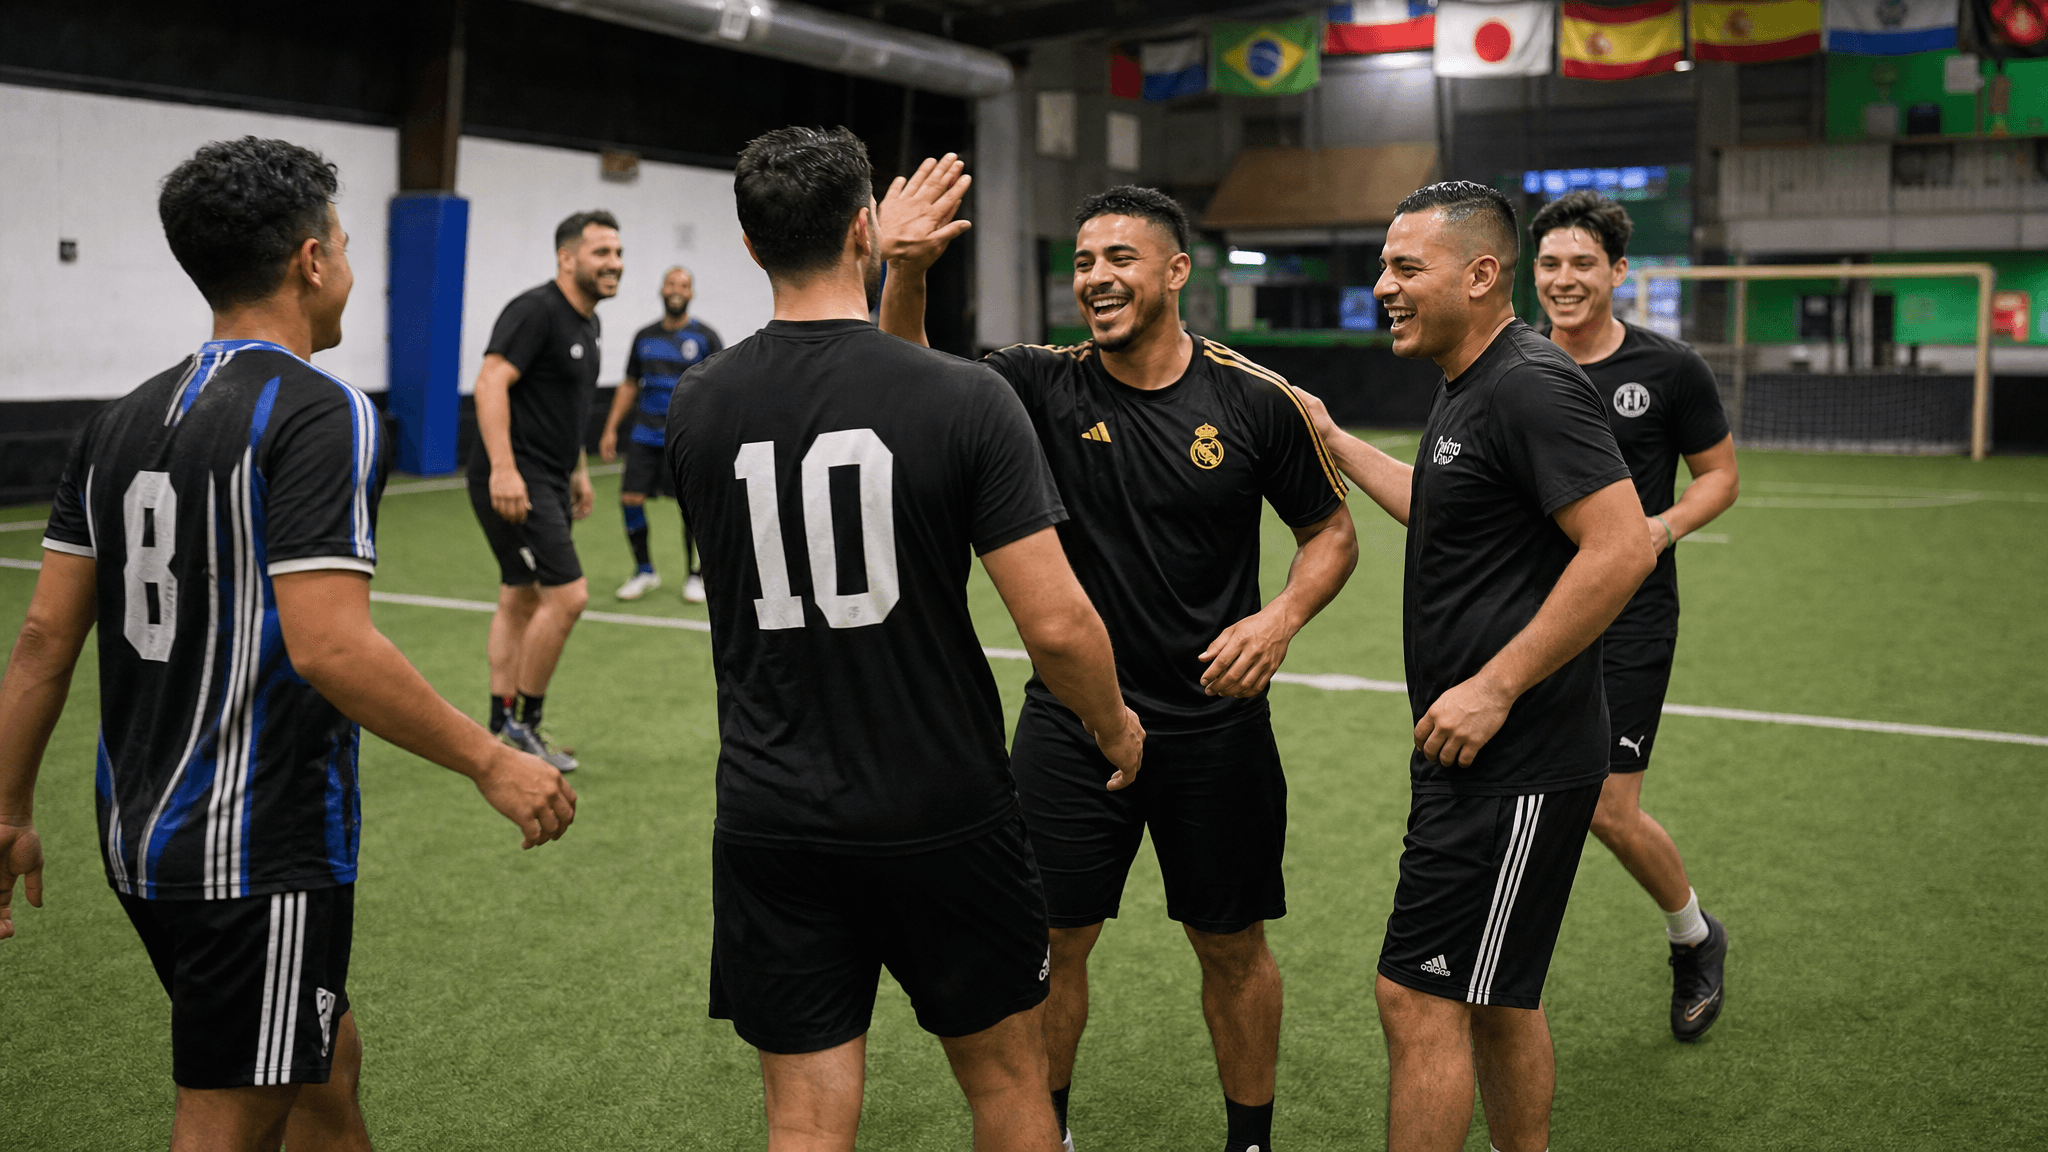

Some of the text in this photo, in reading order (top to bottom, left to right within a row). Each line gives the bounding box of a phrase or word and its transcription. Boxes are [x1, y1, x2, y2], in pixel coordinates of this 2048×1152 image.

[123, 470, 178, 662] 8
[734, 428, 900, 629] 10
[1420, 963, 1451, 977] adidas
